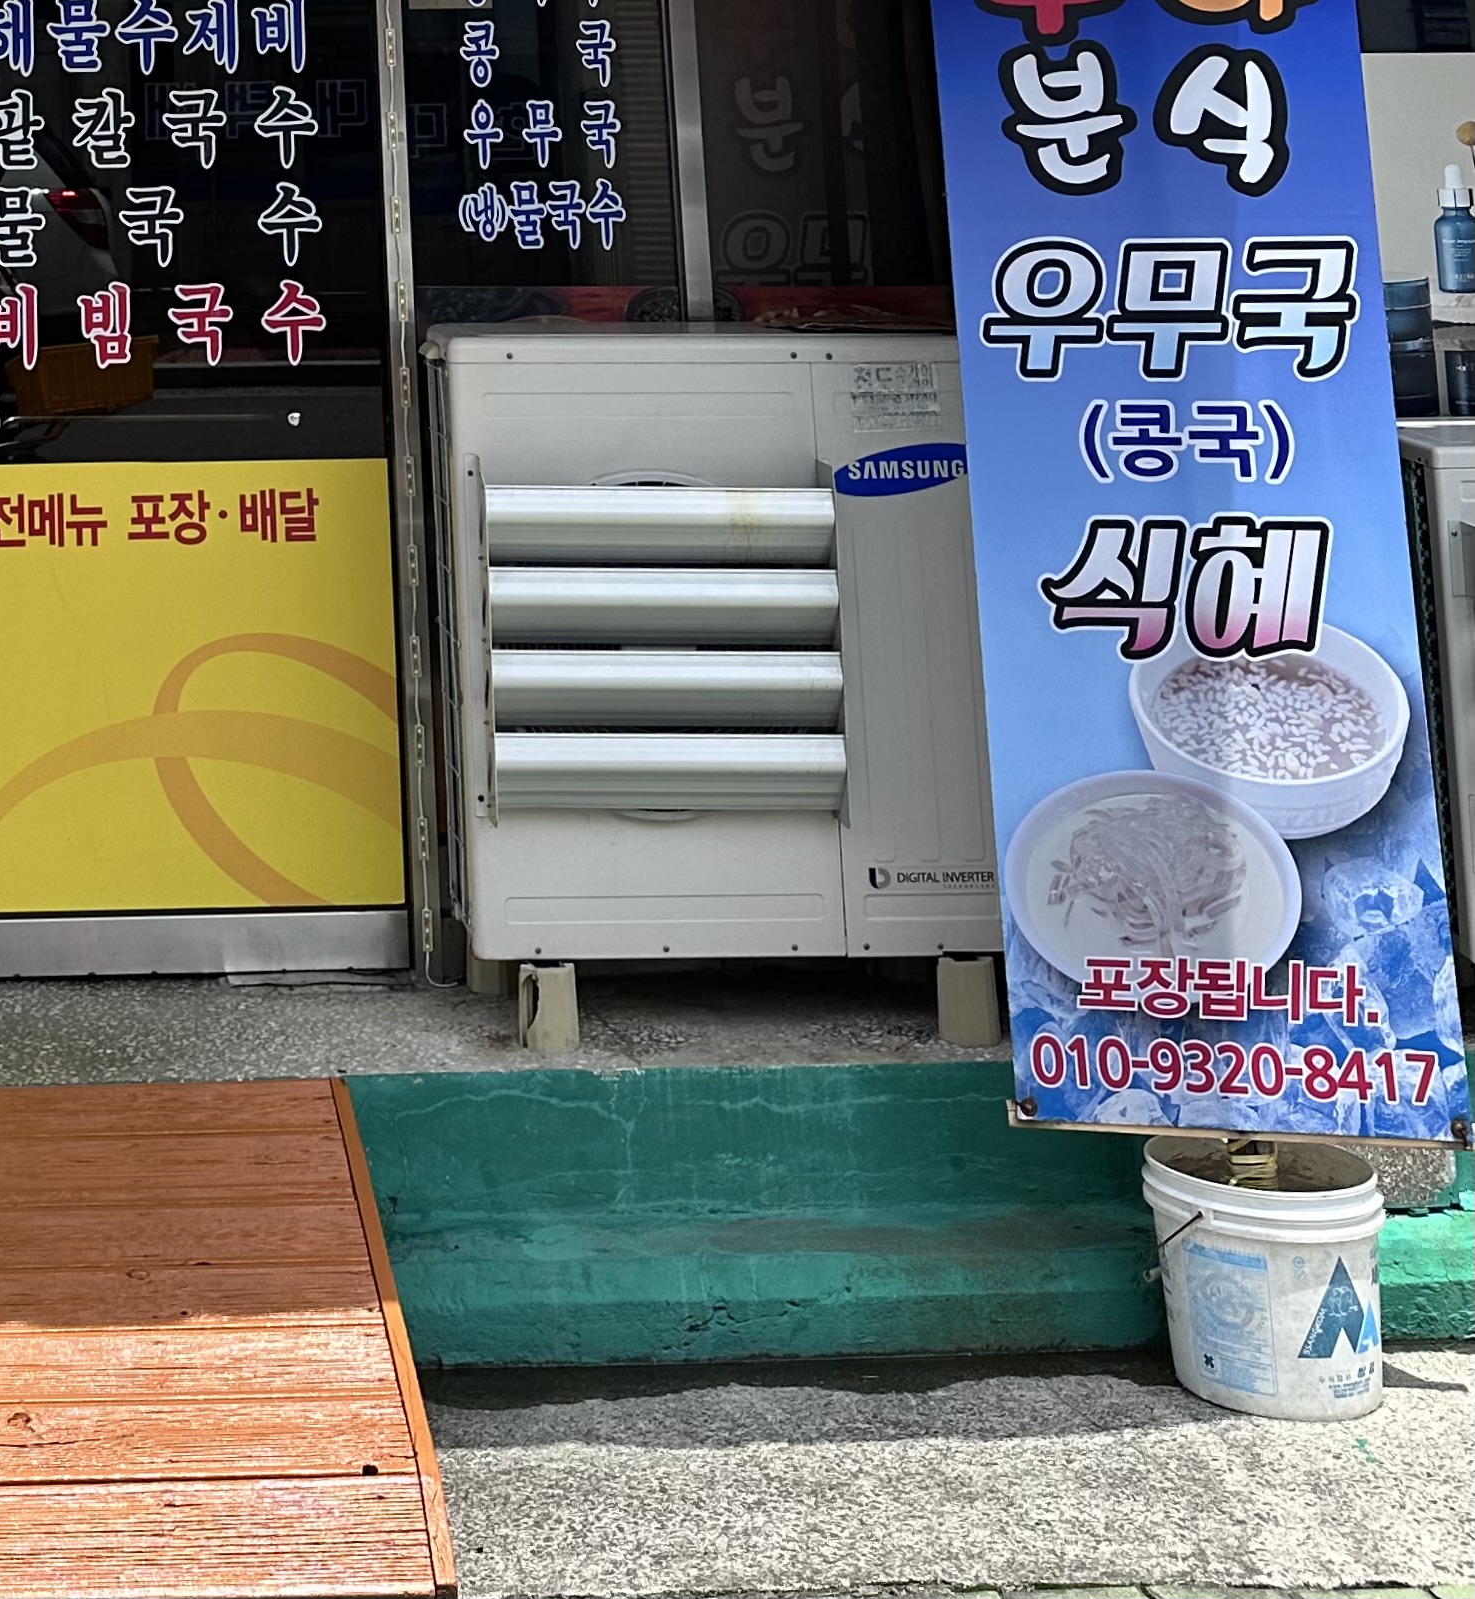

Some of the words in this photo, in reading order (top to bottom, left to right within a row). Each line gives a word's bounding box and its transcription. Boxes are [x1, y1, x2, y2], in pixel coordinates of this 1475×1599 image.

[981, 236, 1361, 382] 우무국
[848, 459, 965, 480] SAMSUNG
[1079, 398, 1295, 483] (콩국)
[1041, 512, 1333, 661] 식혜
[897, 872, 940, 883] DIGITAL
[942, 871, 994, 882] INVERTER
[1077, 956, 1381, 1027] 포장됩니다.
[1029, 1034, 1438, 1109] 010-9320-8417
